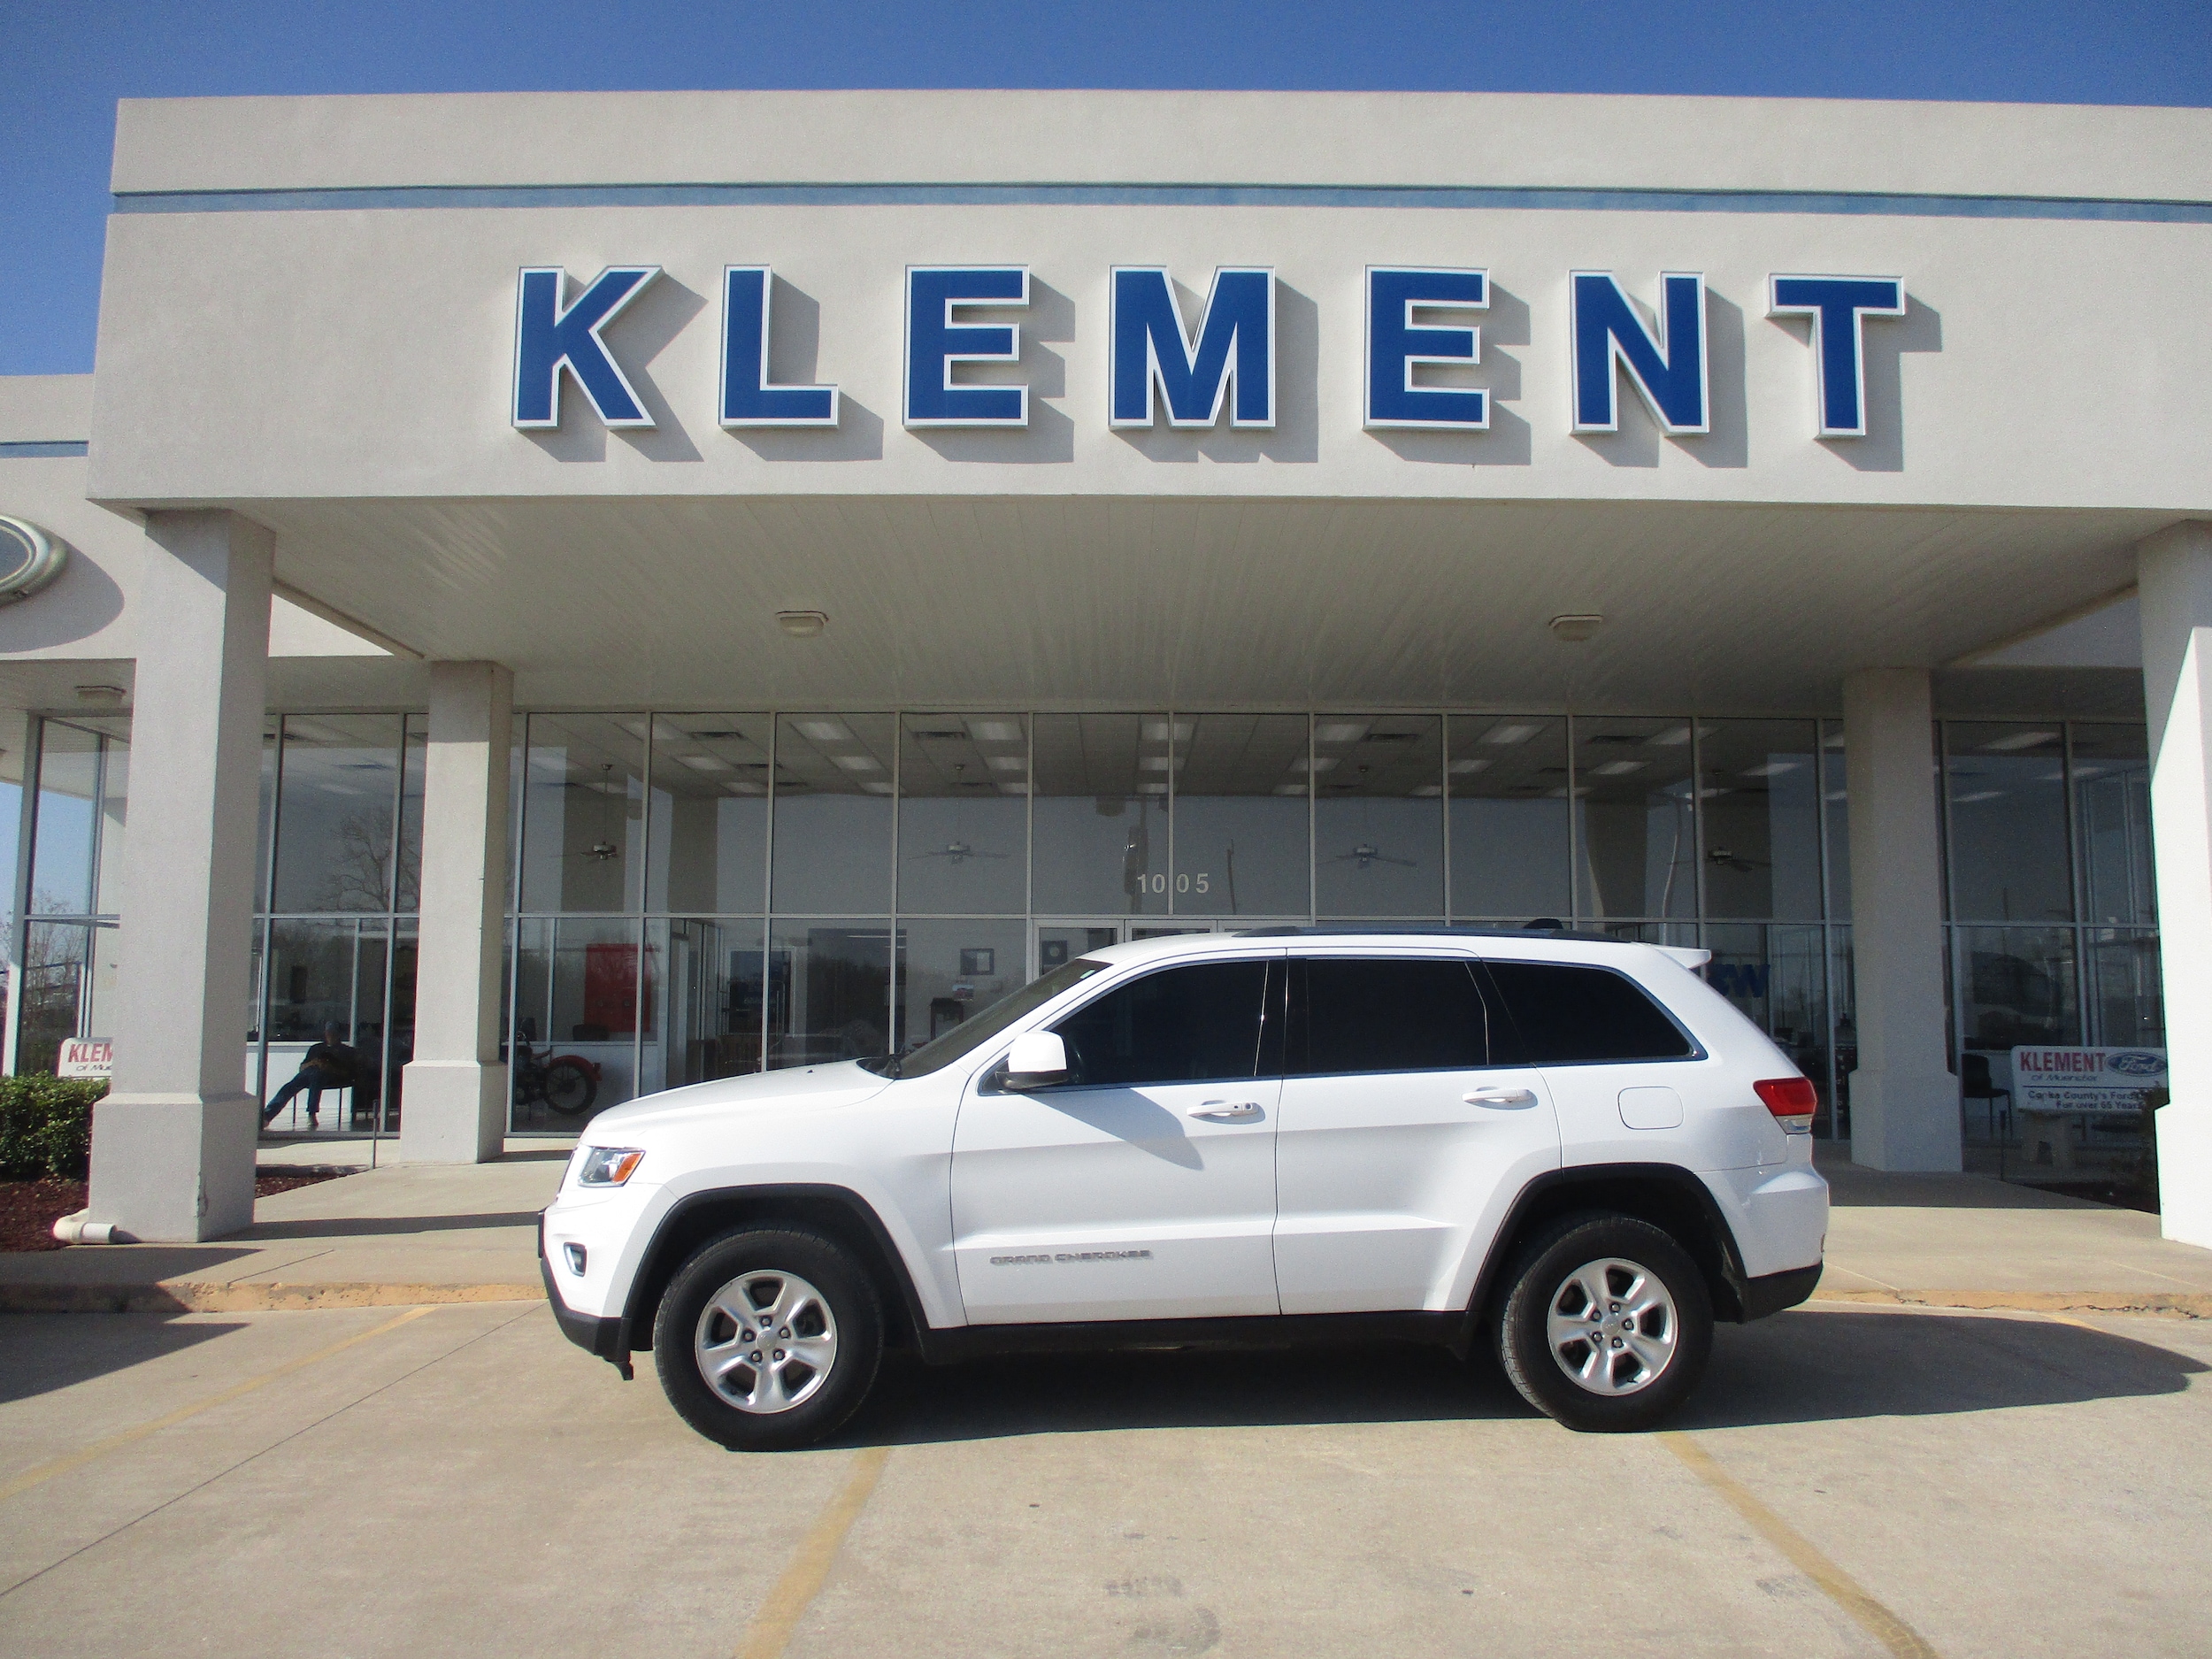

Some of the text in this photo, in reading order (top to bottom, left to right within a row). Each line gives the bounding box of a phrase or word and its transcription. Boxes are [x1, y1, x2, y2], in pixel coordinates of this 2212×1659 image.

[511, 263, 1906, 440] KLEMENT
[1137, 872, 1210, 894] 1005
[2020, 1051, 2107, 1071] KLEMENT
[2118, 1055, 2159, 1072] Ford
[2063, 1091, 2108, 1102] County's
